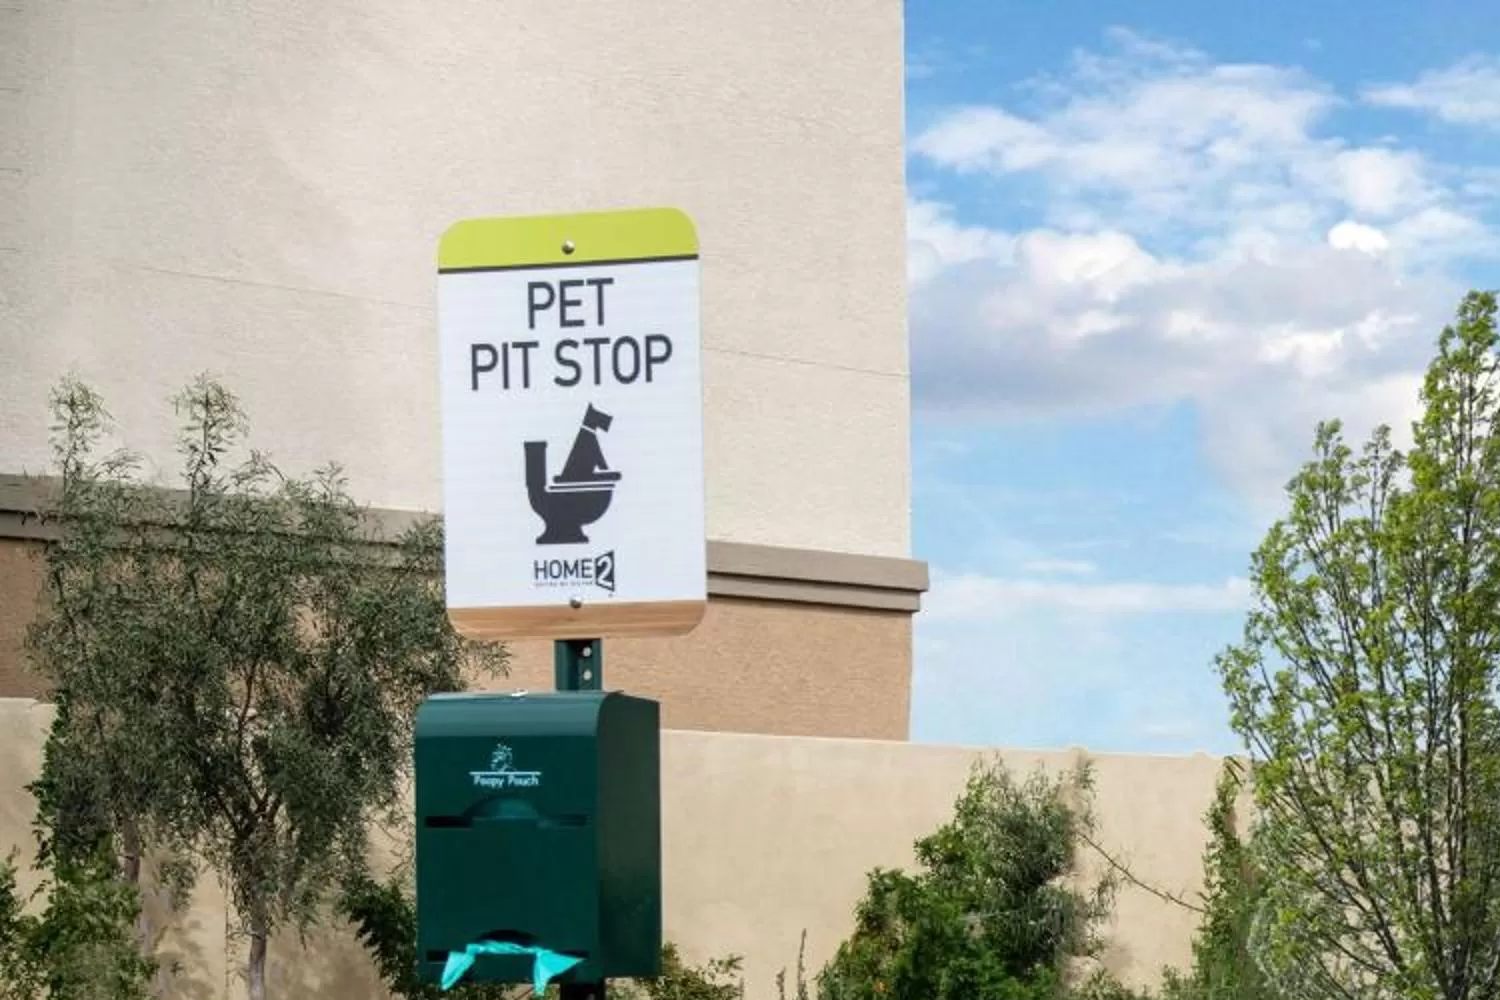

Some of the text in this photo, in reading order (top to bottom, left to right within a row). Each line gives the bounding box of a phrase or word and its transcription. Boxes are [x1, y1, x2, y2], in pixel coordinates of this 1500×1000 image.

[527, 277, 614, 329] PET
[471, 333, 673, 391] PIT STOP
[473, 775, 539, 789] Poopy Pouch
